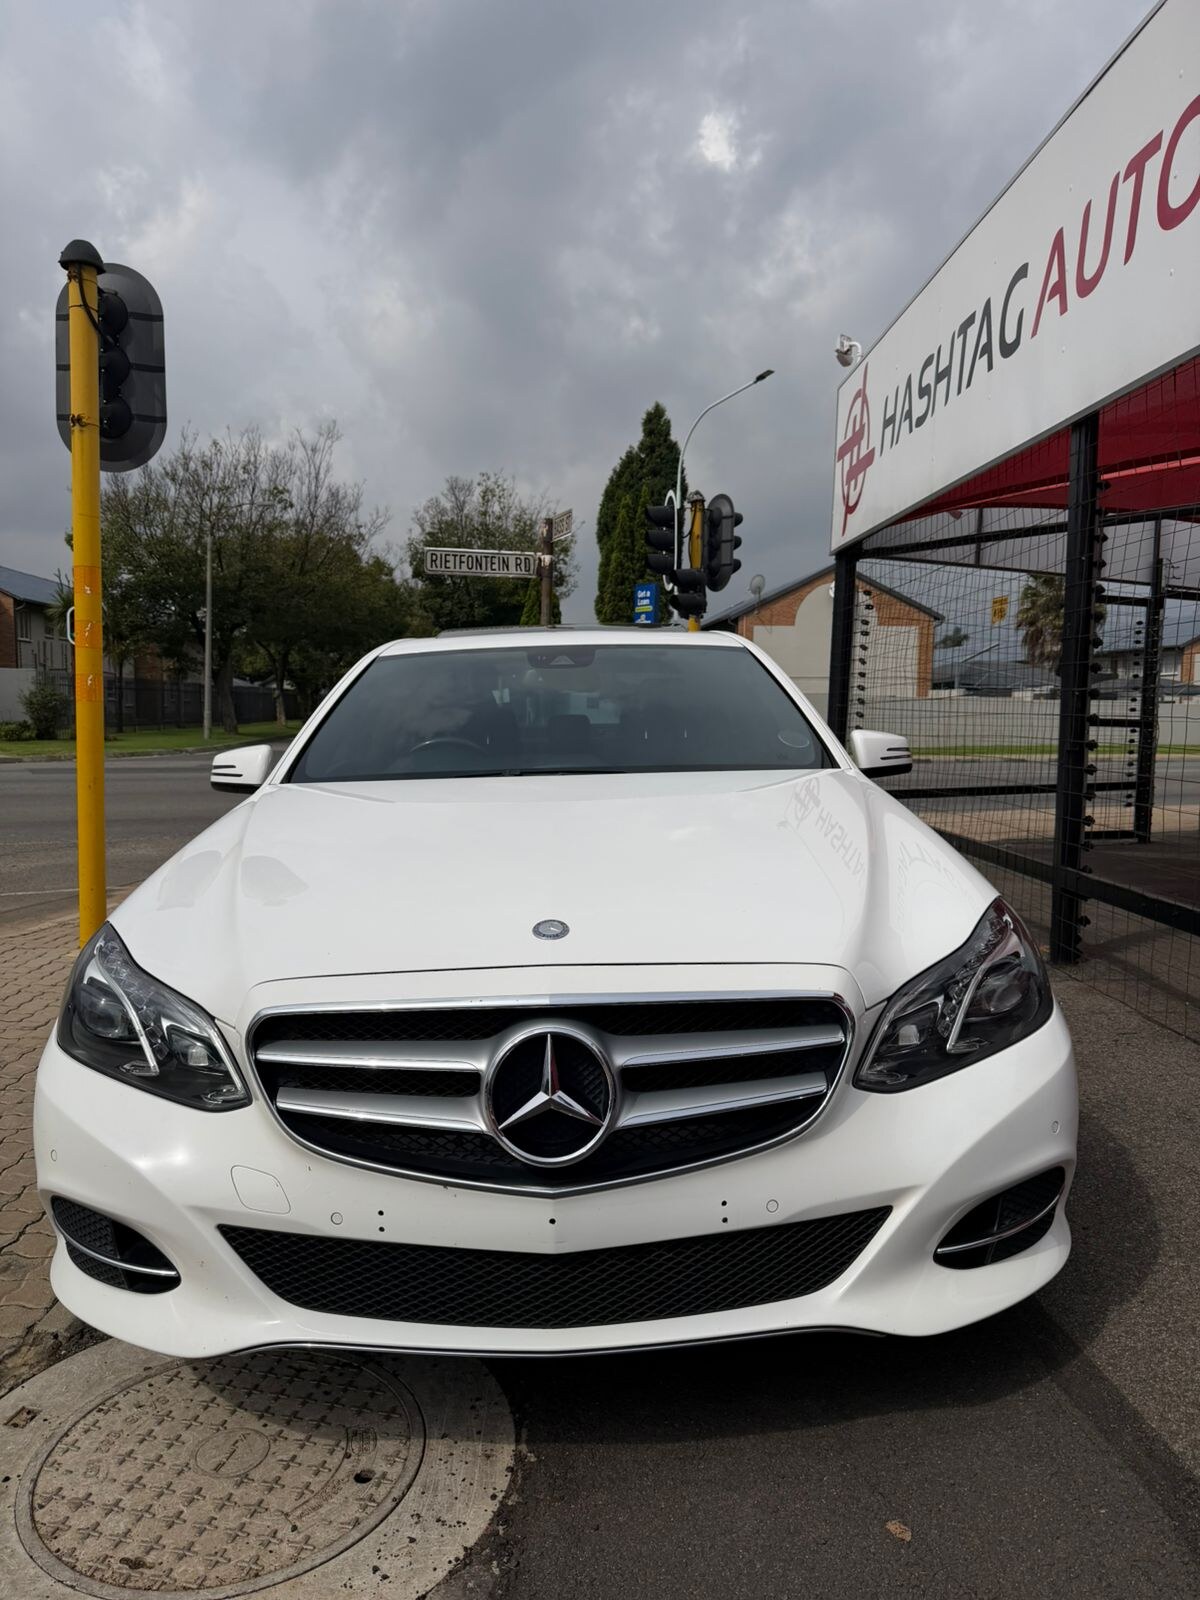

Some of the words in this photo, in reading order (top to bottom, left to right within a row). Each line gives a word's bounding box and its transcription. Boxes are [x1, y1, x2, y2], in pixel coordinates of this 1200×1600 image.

[879, 262, 1029, 455] HASHTAG
[430, 553, 510, 572] RIETFONTEIN
[515, 556, 531, 573] RD
